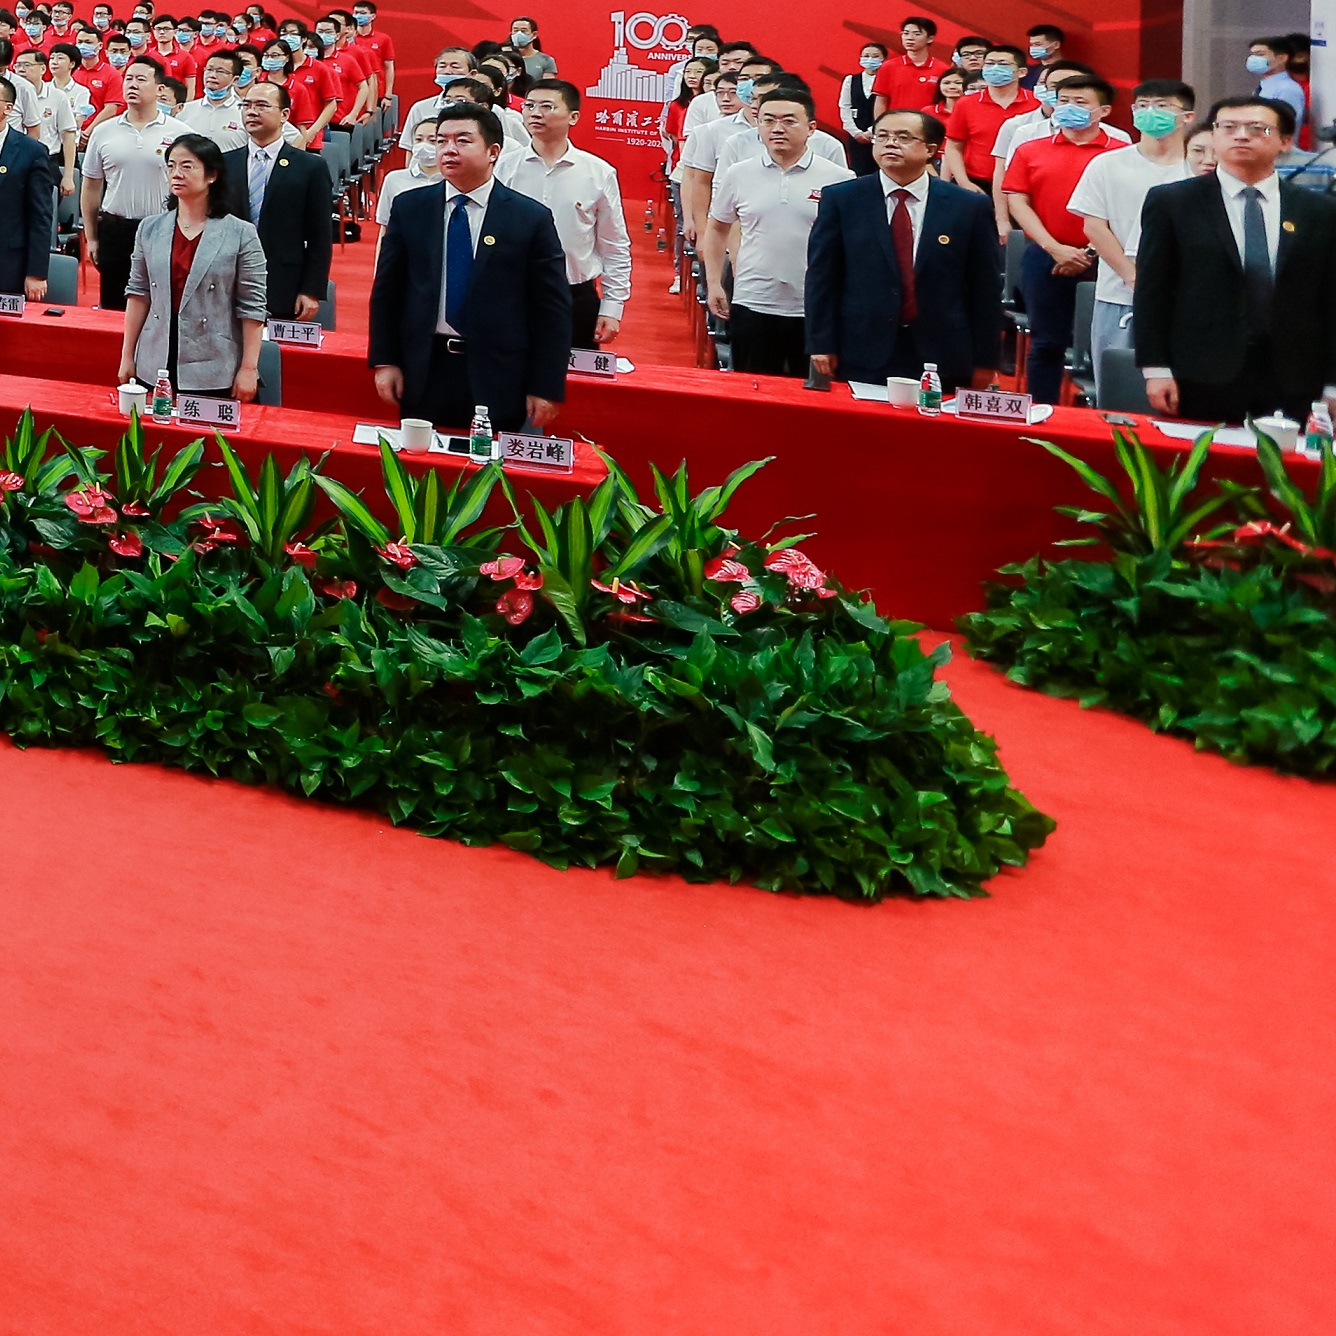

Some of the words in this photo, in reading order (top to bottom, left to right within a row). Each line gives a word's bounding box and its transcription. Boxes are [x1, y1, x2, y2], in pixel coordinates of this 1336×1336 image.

[273, 324, 315, 341] 曹士平
[184, 399, 234, 422] 练聪
[964, 393, 1024, 415] 韩喜双
[507, 438, 565, 462] 娄岩峰
